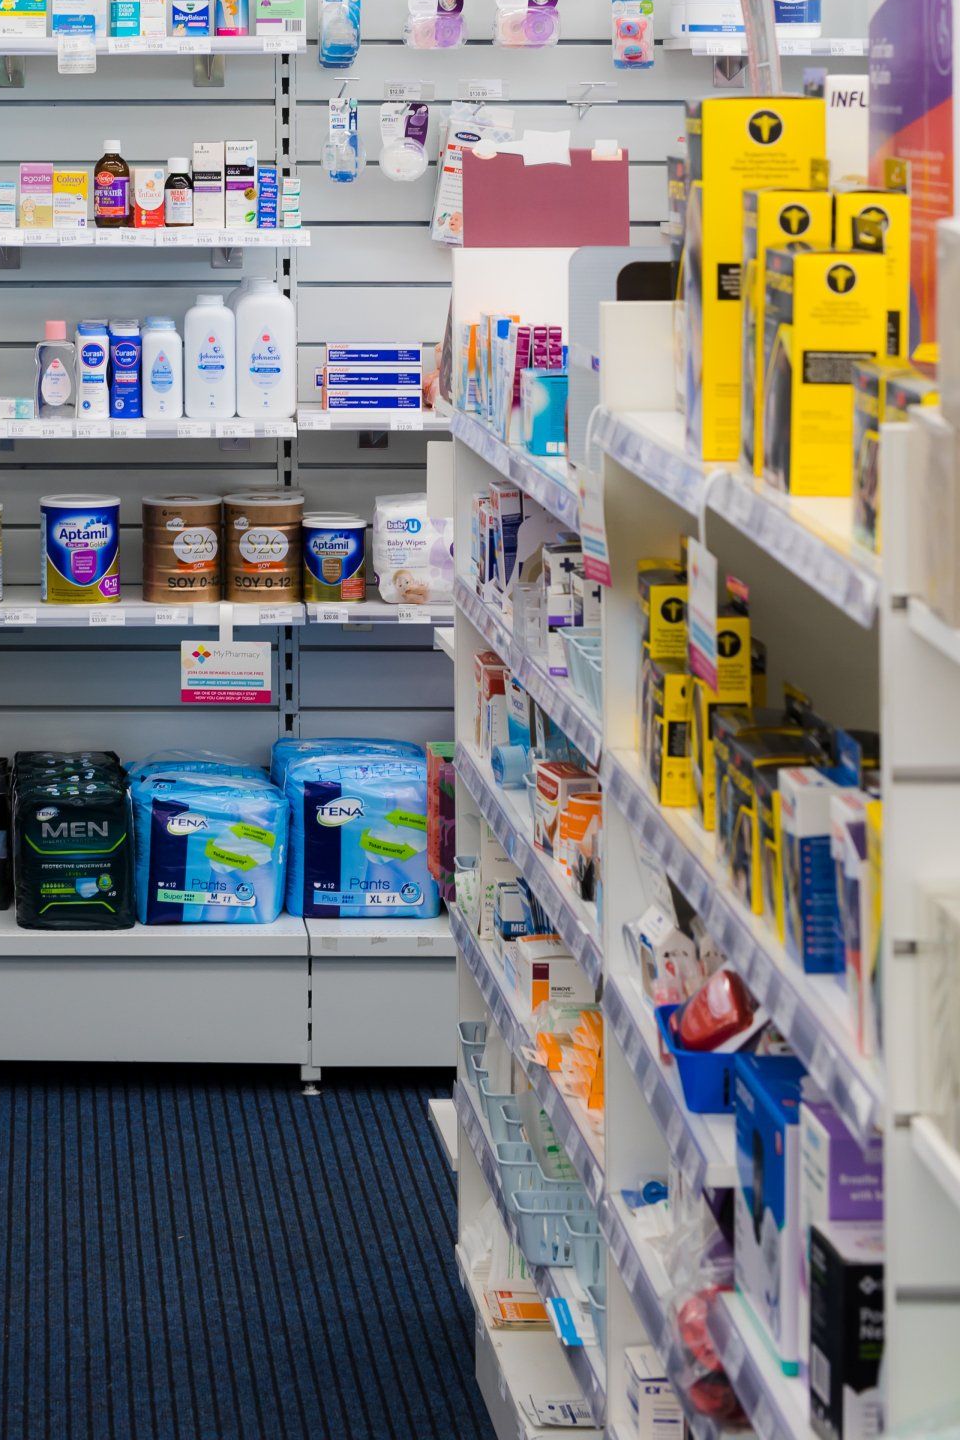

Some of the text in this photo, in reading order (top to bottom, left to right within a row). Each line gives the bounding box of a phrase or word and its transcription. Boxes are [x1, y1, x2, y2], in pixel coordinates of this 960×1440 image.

[22, 175, 51, 183] egozite
[56, 175, 85, 184] Coloxyl
[81, 350, 104, 358] Curash
[115, 349, 137, 357] Curash
[198, 352, 225, 362] Johnson's
[251, 352, 281, 364] Johnson's
[59, 528, 108, 542] Aptamil
[181, 533, 215, 555] S26
[245, 533, 283, 553] S26
[312, 539, 349, 550] Aptamil
[387, 539, 427, 547] Baby Wipes
[104, 578, 118, 587] 0-12
[168, 577, 196, 588] SOY
[235, 576, 260, 588] SOY
[265, 576, 290, 588] 0-12
[213, 650, 260, 659] My Pharmacy
[317, 806, 364, 817] TENA
[168, 817, 208, 828] TENA
[41, 821, 109, 838] MEN
[213, 850, 226, 859] Total
[191, 878, 227, 891] Pants
[349, 877, 390, 890] Pants
[163, 892, 183, 901] Super
[321, 894, 338, 902] Plus
[369, 895, 382, 904] XL
